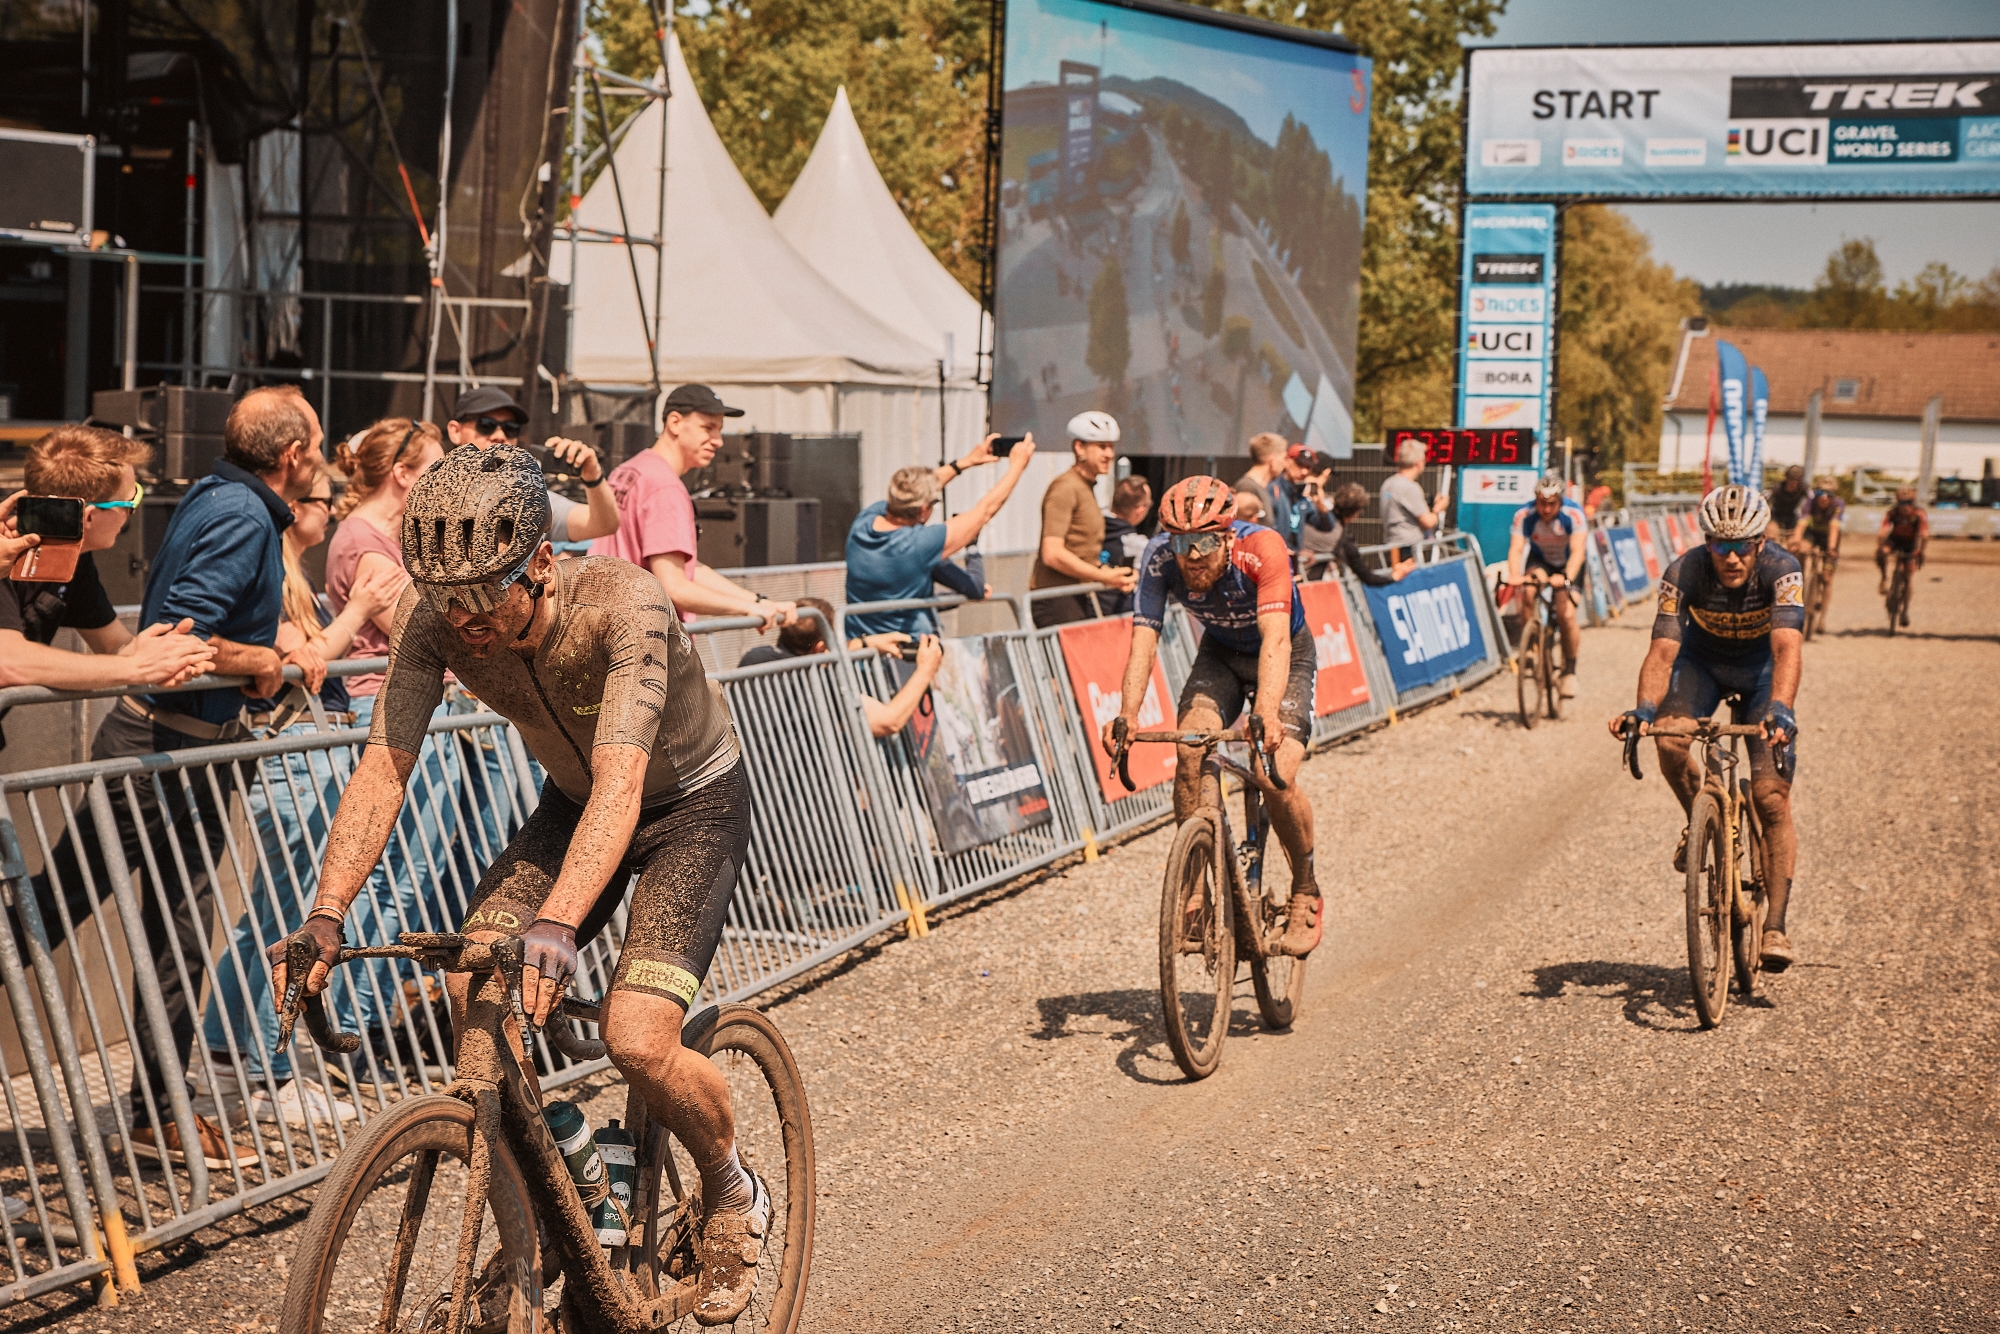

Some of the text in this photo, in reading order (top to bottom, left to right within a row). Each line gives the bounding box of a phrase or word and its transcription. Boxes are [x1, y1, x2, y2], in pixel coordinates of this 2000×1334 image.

[1802, 81, 1991, 110] TREK
[1532, 89, 1660, 120] START
[1746, 127, 1820, 156] UCI
[1834, 125, 1899, 141] GRAVEL
[1833, 141, 1951, 158] WORLD SERIES
[1475, 262, 1540, 275] TREK
[1481, 332, 1532, 351] UCI
[1484, 372, 1533, 384] BORA
[604, 1212, 622, 1221] SPO
